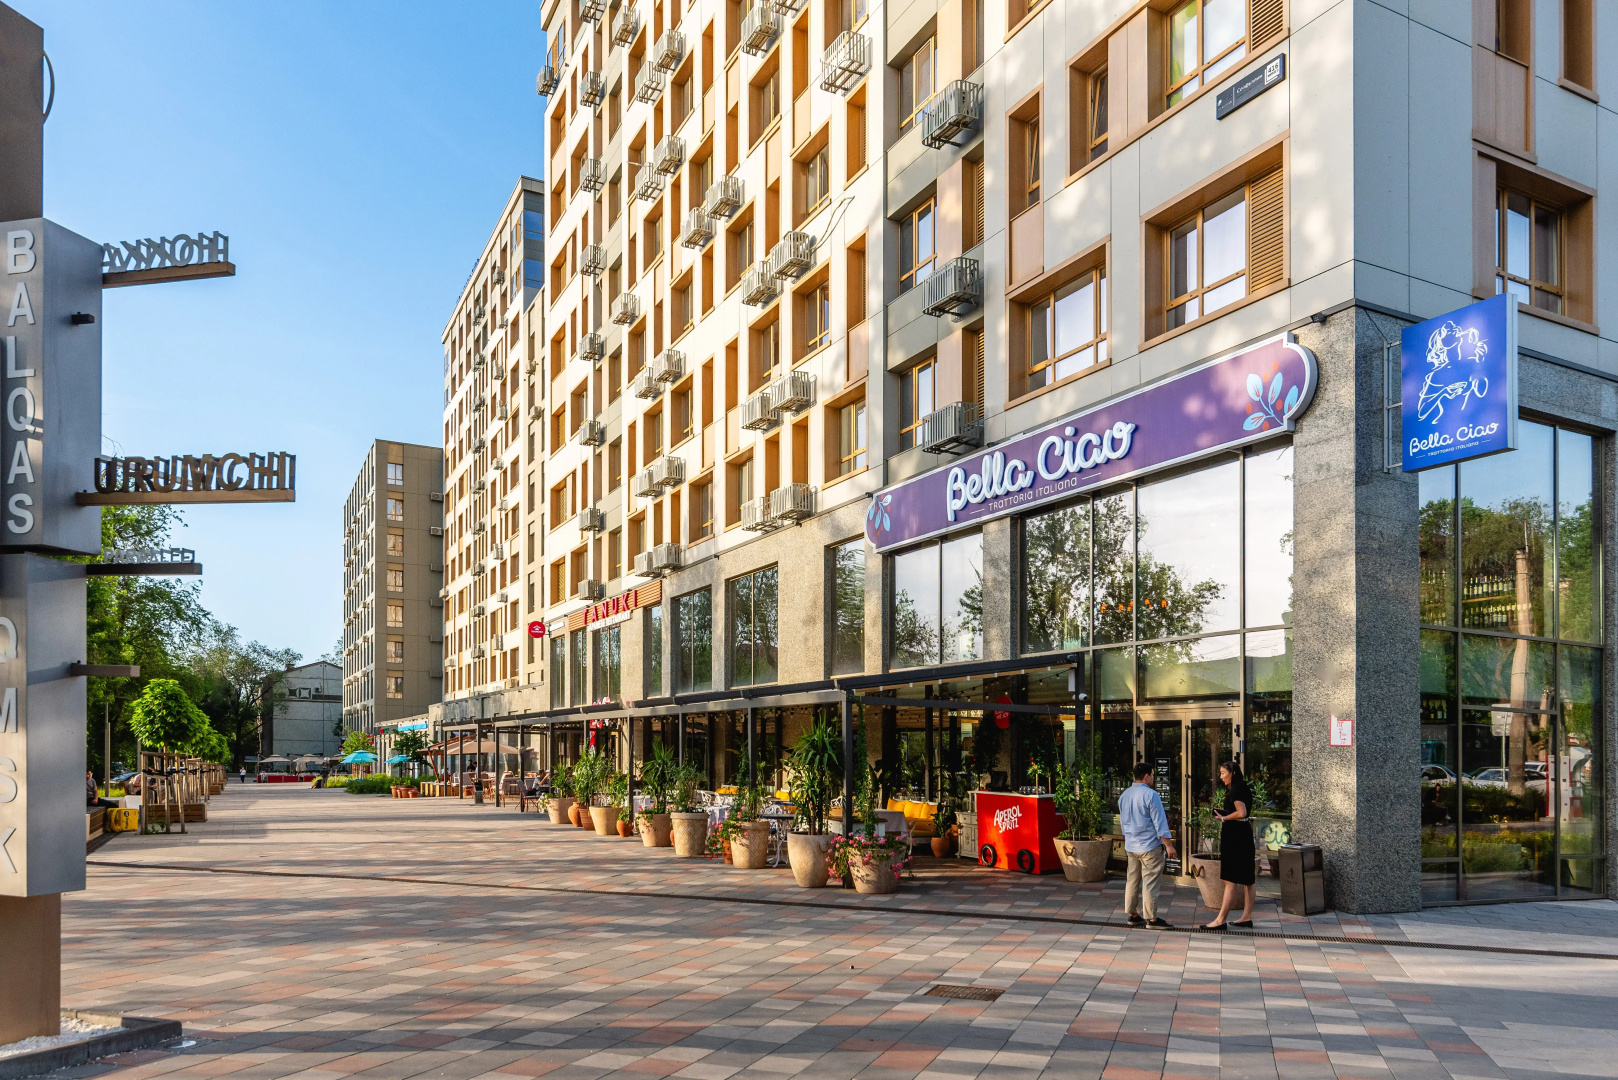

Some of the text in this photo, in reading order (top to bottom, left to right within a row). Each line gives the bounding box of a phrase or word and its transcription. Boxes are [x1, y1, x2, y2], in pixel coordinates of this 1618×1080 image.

[6, 229, 36, 534] BALQAS
[1410, 422, 1499, 456] Bella Ciao
[94, 451, 296, 493] URUMCHI
[946, 421, 1136, 521] Bella Ciao
[583, 590, 637, 624] TANUKI
[994, 805, 1022, 826] APEROL
[999, 818, 1019, 833] SPRITZ
